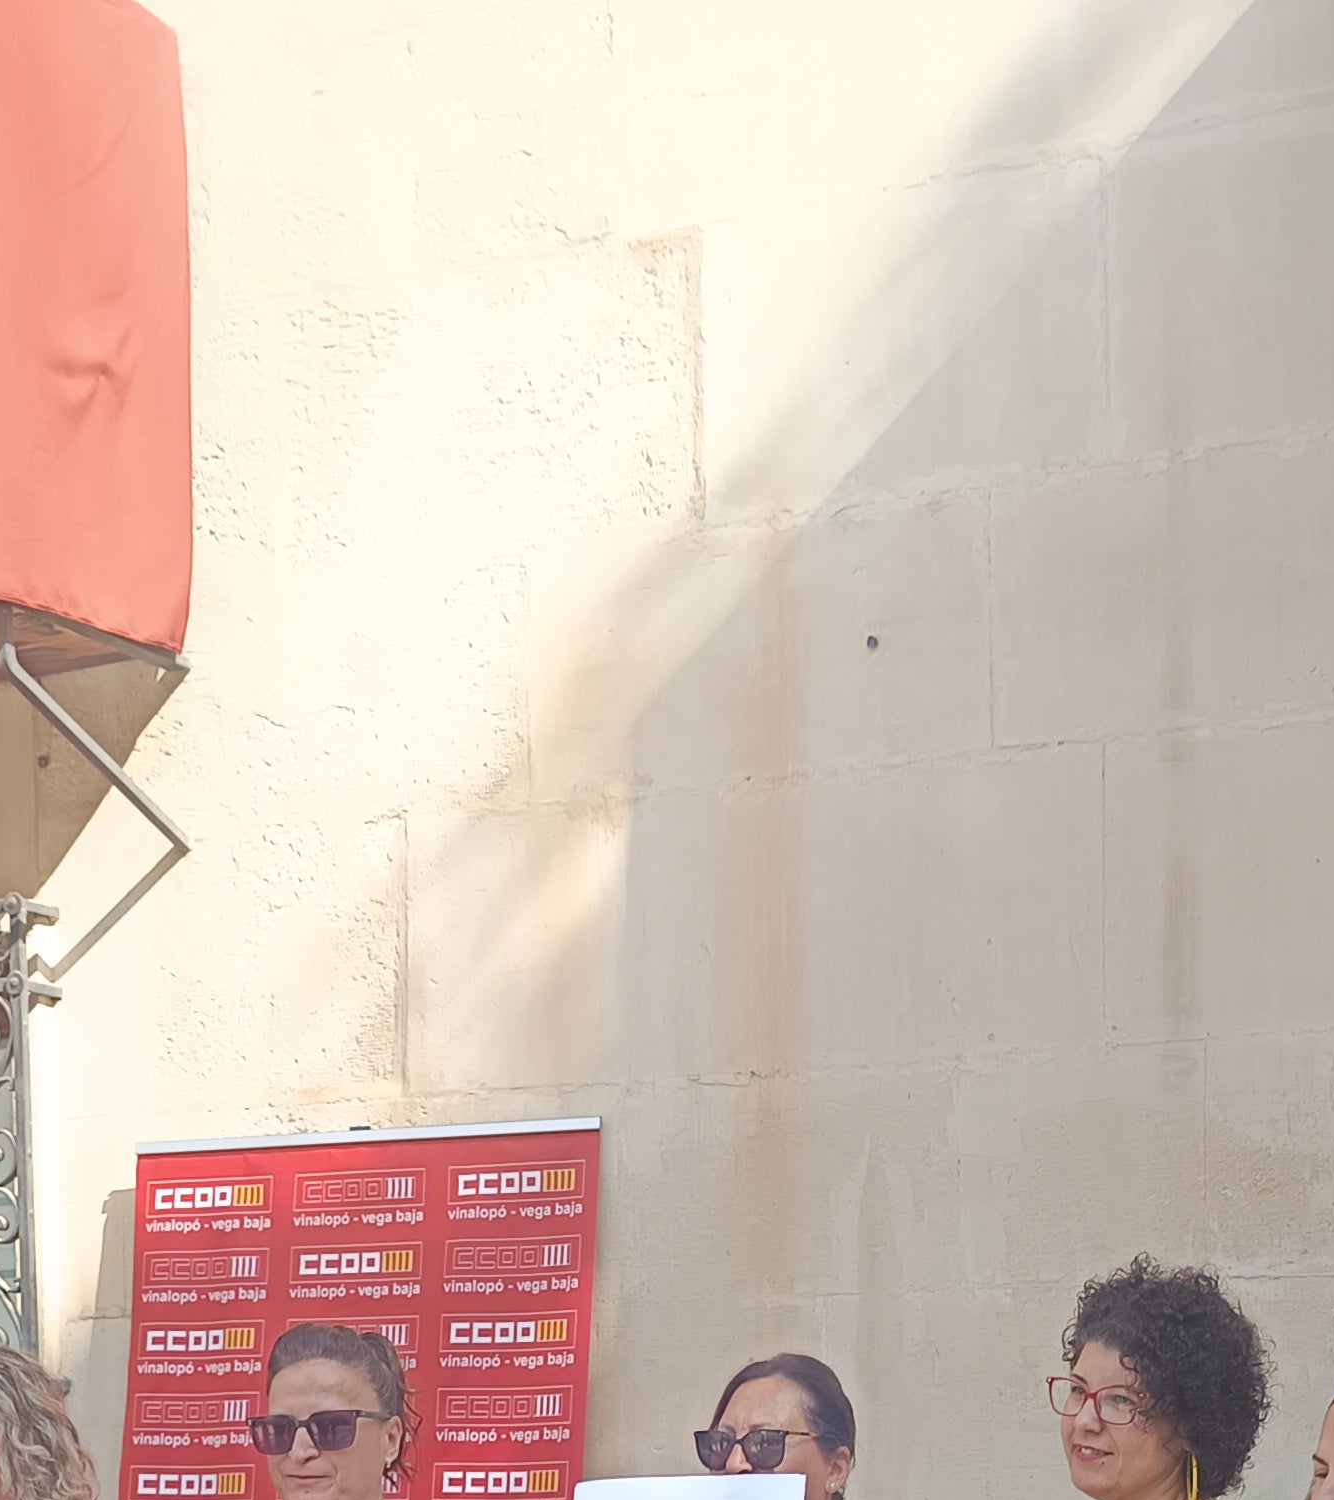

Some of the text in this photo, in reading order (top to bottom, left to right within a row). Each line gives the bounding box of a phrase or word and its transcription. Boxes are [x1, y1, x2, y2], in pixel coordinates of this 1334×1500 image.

[457, 1170, 541, 1196] CCOO
[155, 1186, 232, 1210] CCOO
[293, 1209, 423, 1228] vinalopó vega baja
[448, 1201, 583, 1220] vinalopó vega baja
[145, 1216, 271, 1234] vinalopó vega baja
[299, 1252, 380, 1274] CCOO
[289, 1282, 421, 1300] vinalopó vega baja
[443, 1276, 579, 1295] vinalopó vega baja
[142, 1287, 267, 1304] vinalopó vega baja
[147, 1330, 223, 1352] CCOO
[450, 1322, 535, 1344] CCOO
[137, 1359, 261, 1376] vinalopó vega baja
[439, 1351, 575, 1370] vinalopó vega baja
[133, 1432, 191, 1448] vinalopó
[201, 1434, 227, 1447] vega
[436, 1426, 570, 1444] vinalopó vega baja
[137, 1474, 217, 1494] CCOO
[442, 1470, 528, 1493] CCOO
